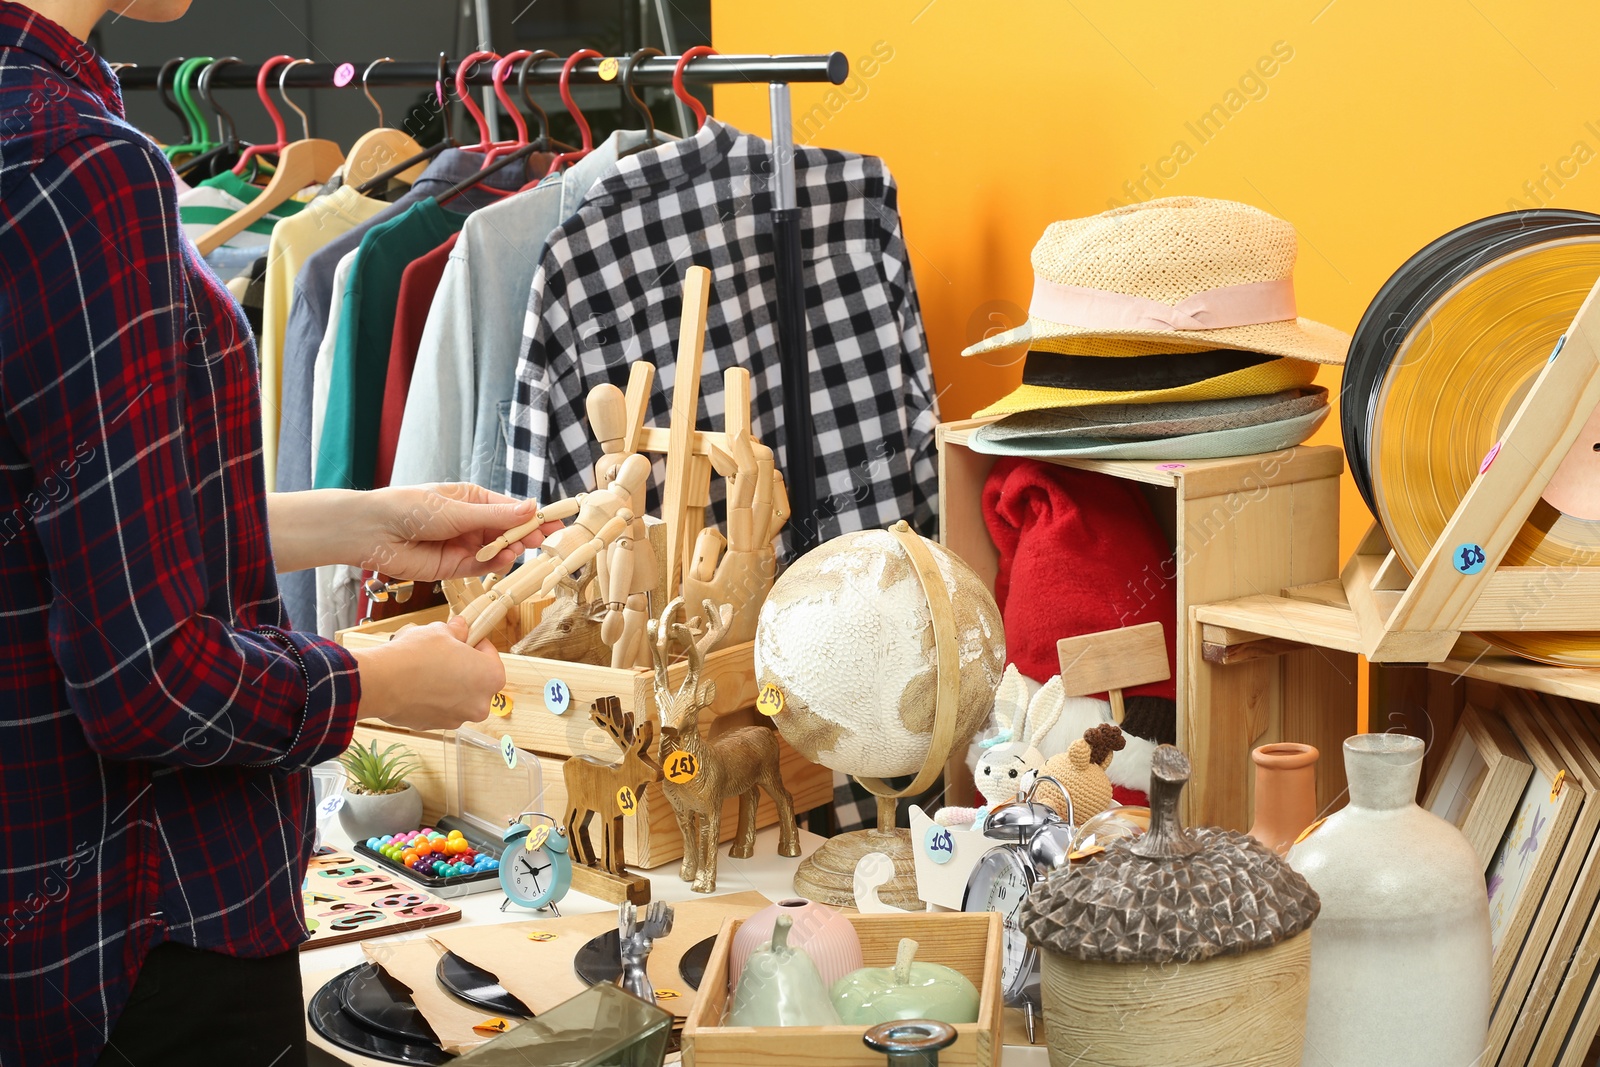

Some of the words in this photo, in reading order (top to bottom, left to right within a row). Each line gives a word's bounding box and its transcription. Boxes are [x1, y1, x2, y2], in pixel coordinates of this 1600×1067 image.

[1460, 545, 1485, 571] 10$
[760, 687, 781, 710] 15$
[669, 754, 694, 778] 15$
[323, 797, 341, 815] 3$
[620, 788, 634, 810] 9$
[530, 827, 549, 848] 3$
[930, 829, 952, 854] 10$
[1008, 873, 1016, 888] 11
[998, 885, 1007, 901] 10
